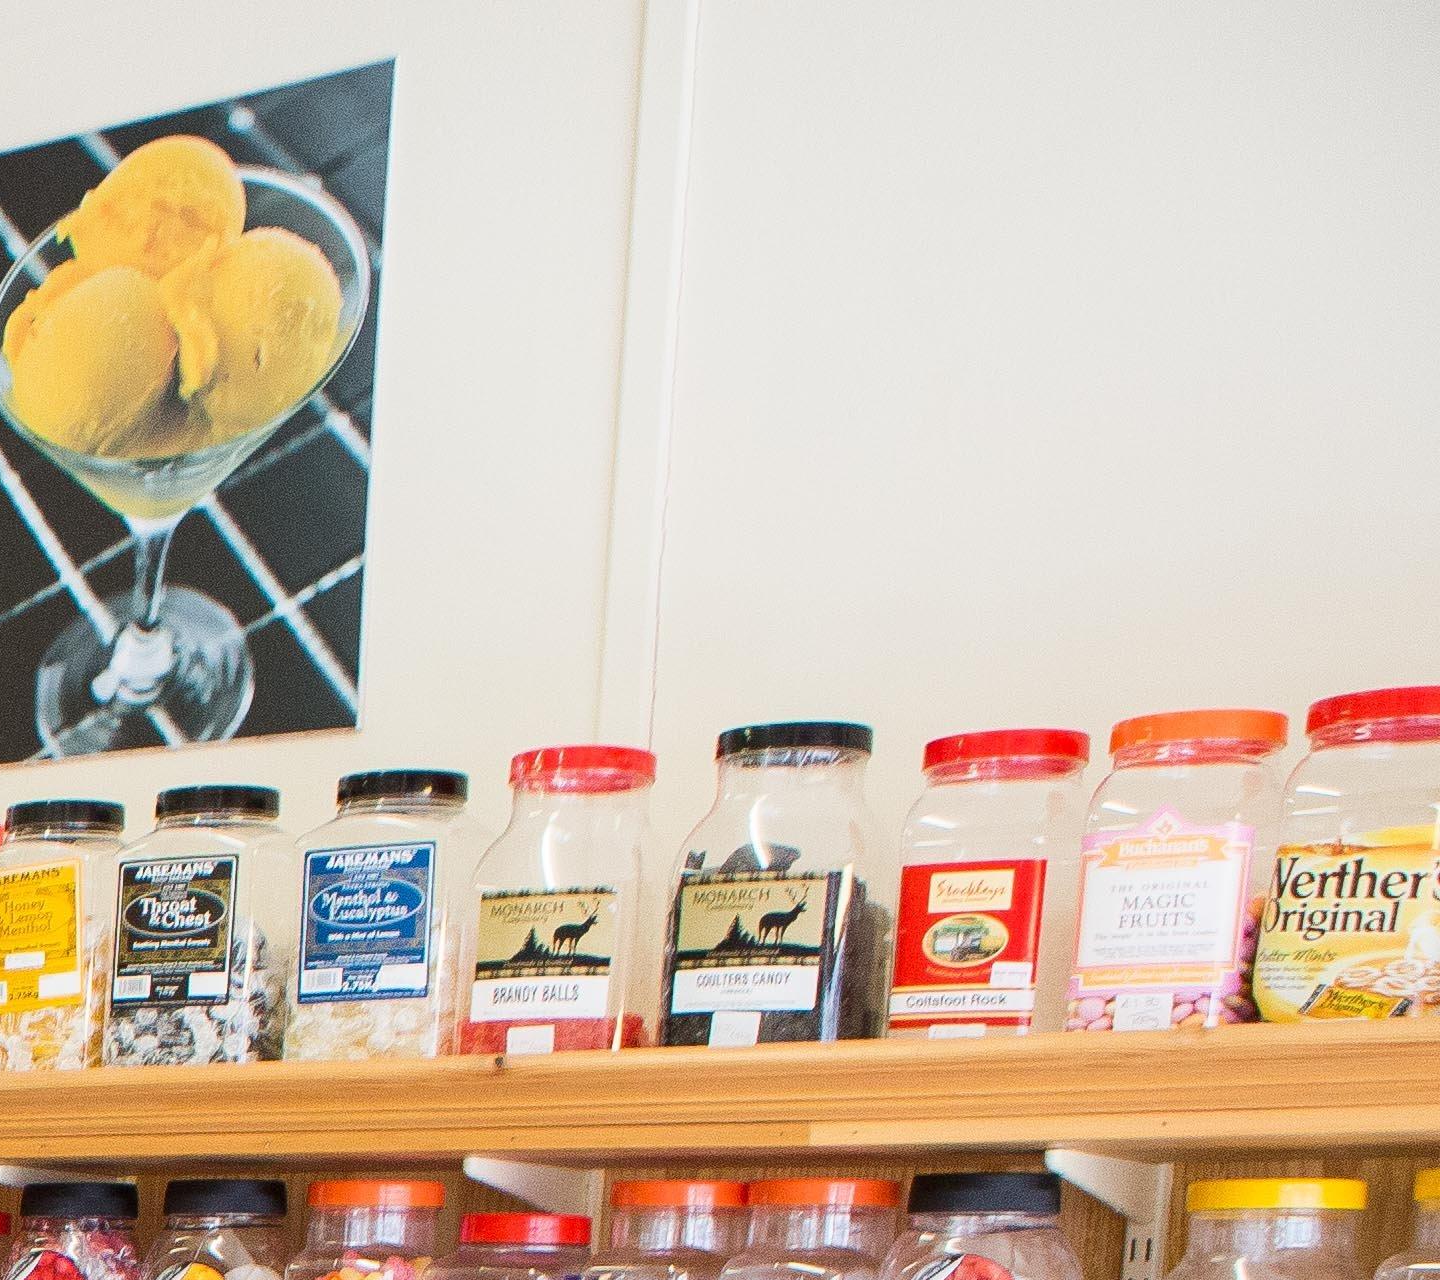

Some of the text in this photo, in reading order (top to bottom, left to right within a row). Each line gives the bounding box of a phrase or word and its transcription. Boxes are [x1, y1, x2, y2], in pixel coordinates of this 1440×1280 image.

[693, 887, 771, 905] MONARCH
[4, 900, 45, 913] Honey
[490, 901, 565, 918] MONARCH
[493, 984, 580, 1004] BRANDY BALLS
[906, 993, 1006, 1008] Coltsfoot Rock
